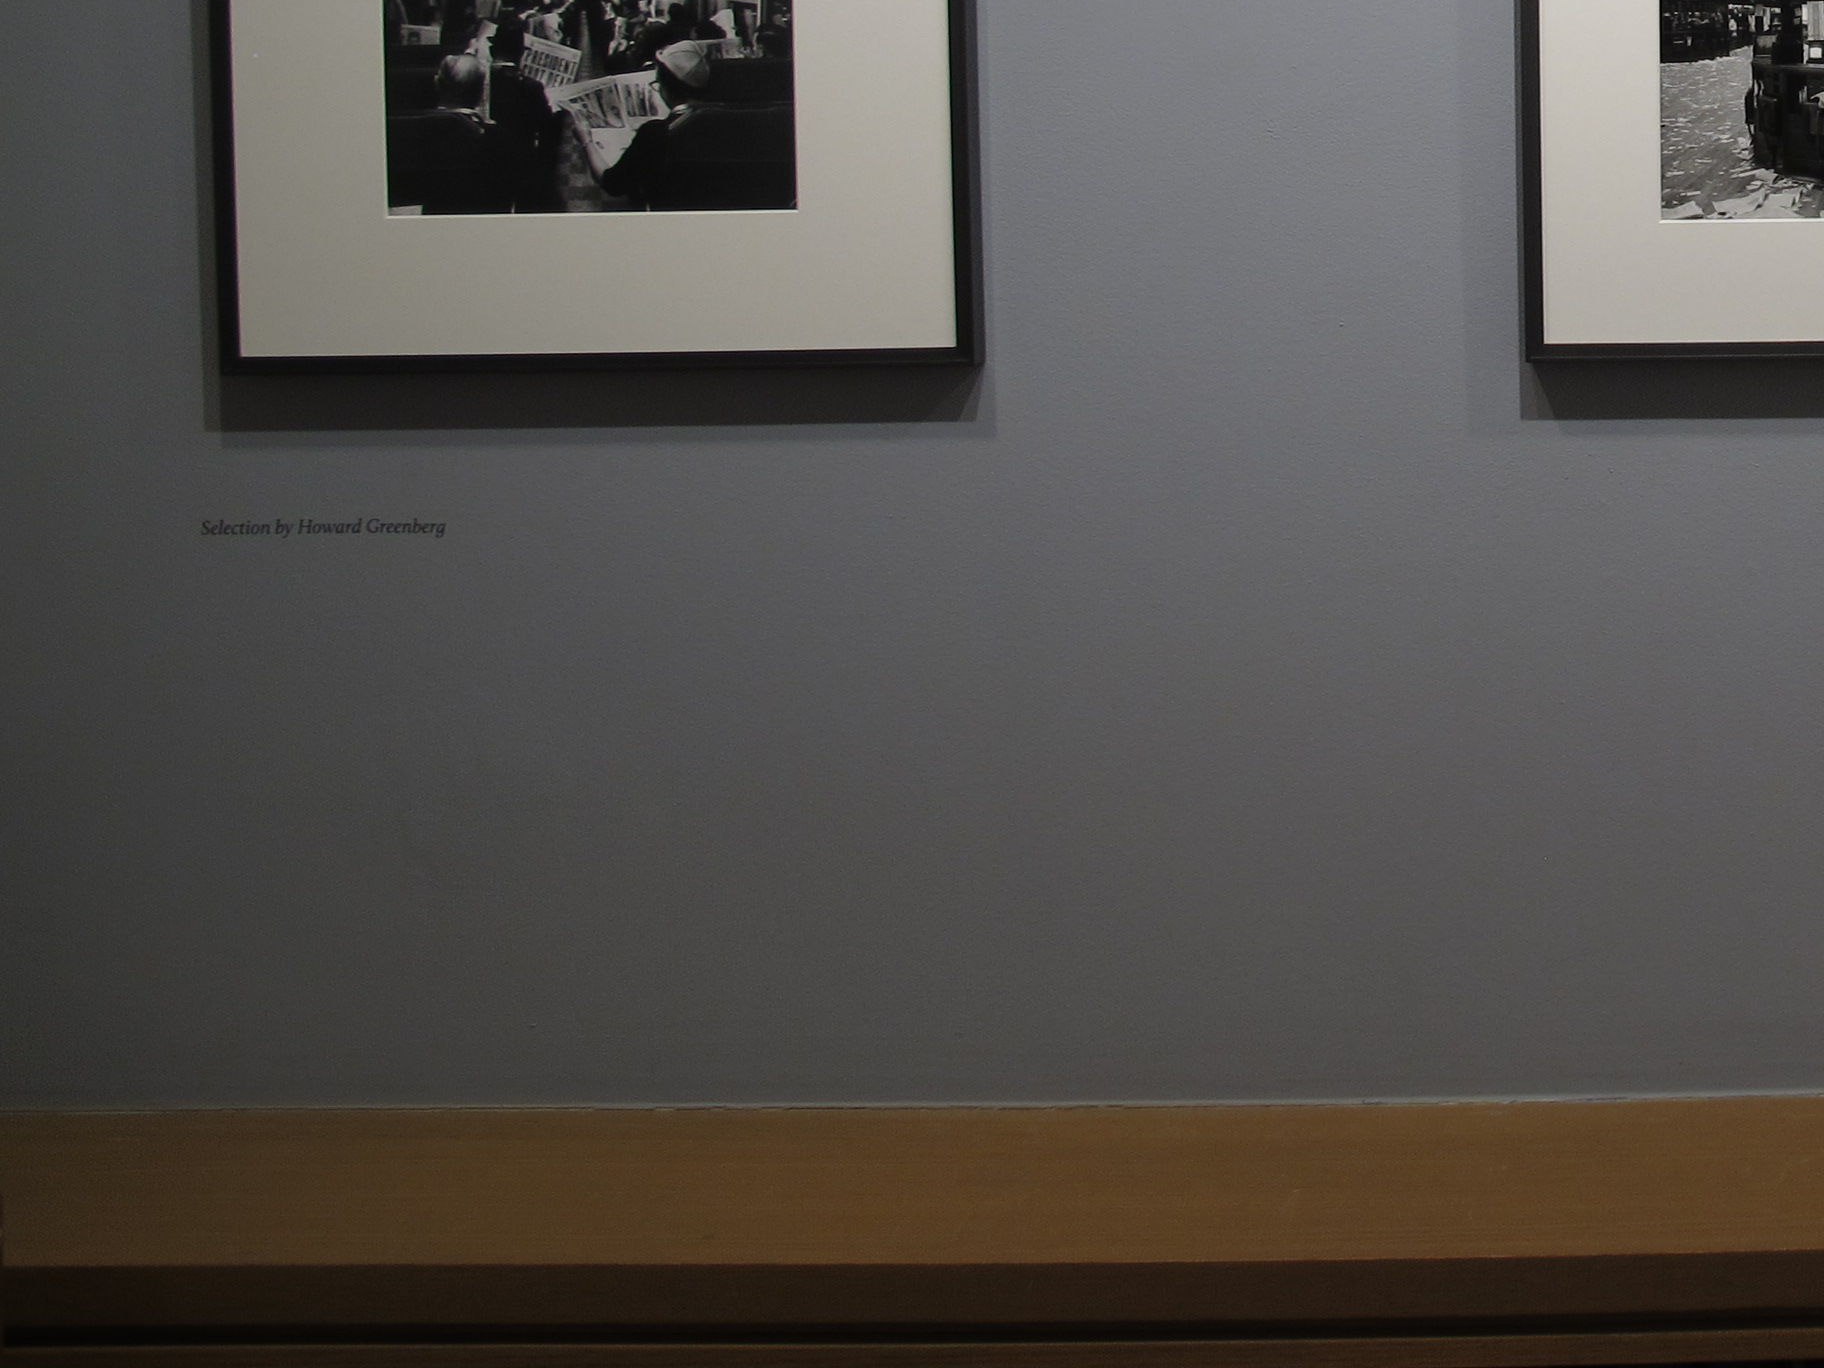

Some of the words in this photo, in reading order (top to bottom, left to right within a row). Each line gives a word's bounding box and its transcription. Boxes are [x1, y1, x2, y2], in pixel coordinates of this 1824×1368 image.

[524, 49, 577, 75] PRESIDENT
[201, 519, 270, 536] Selection
[275, 519, 293, 538] by
[298, 518, 362, 534] Howard
[366, 518, 446, 538] Greenberg
